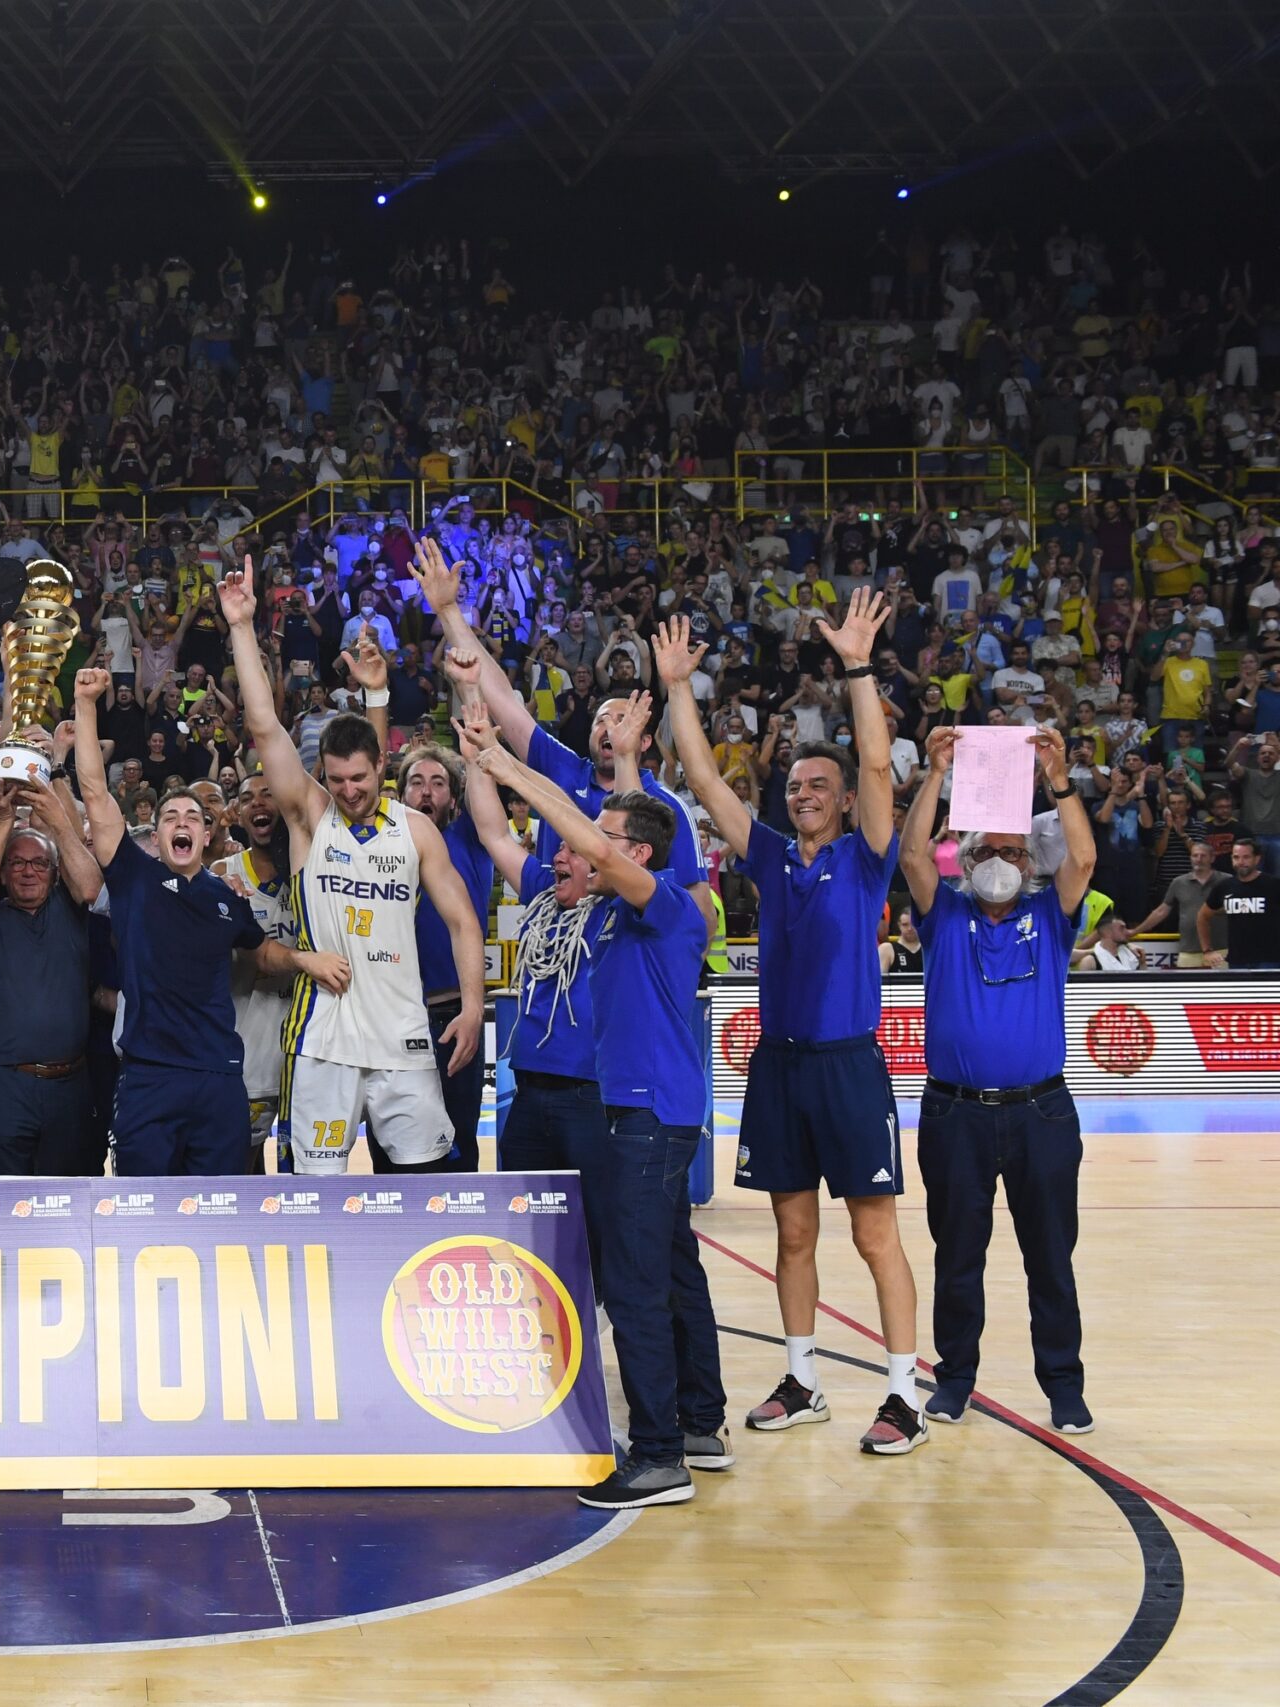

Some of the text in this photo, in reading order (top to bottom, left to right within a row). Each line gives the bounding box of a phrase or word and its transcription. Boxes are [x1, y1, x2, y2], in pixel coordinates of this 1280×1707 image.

[368, 855, 406, 865] PELLINI
[377, 865, 398, 873] TOP
[345, 905, 374, 937] 13
[313, 1119, 347, 1147] 13
[33, 1195, 71, 1208] LNP
[115, 1194, 154, 1206] LNP
[198, 1194, 237, 1205] LNP
[280, 1193, 319, 1205] LNP
[363, 1192, 402, 1204] LNP
[446, 1192, 484, 1204] LNP
[528, 1192, 566, 1204] LNP
[427, 1262, 524, 1306] OLD
[417, 1307, 543, 1351] WILD
[415, 1352, 552, 1396] WEST
